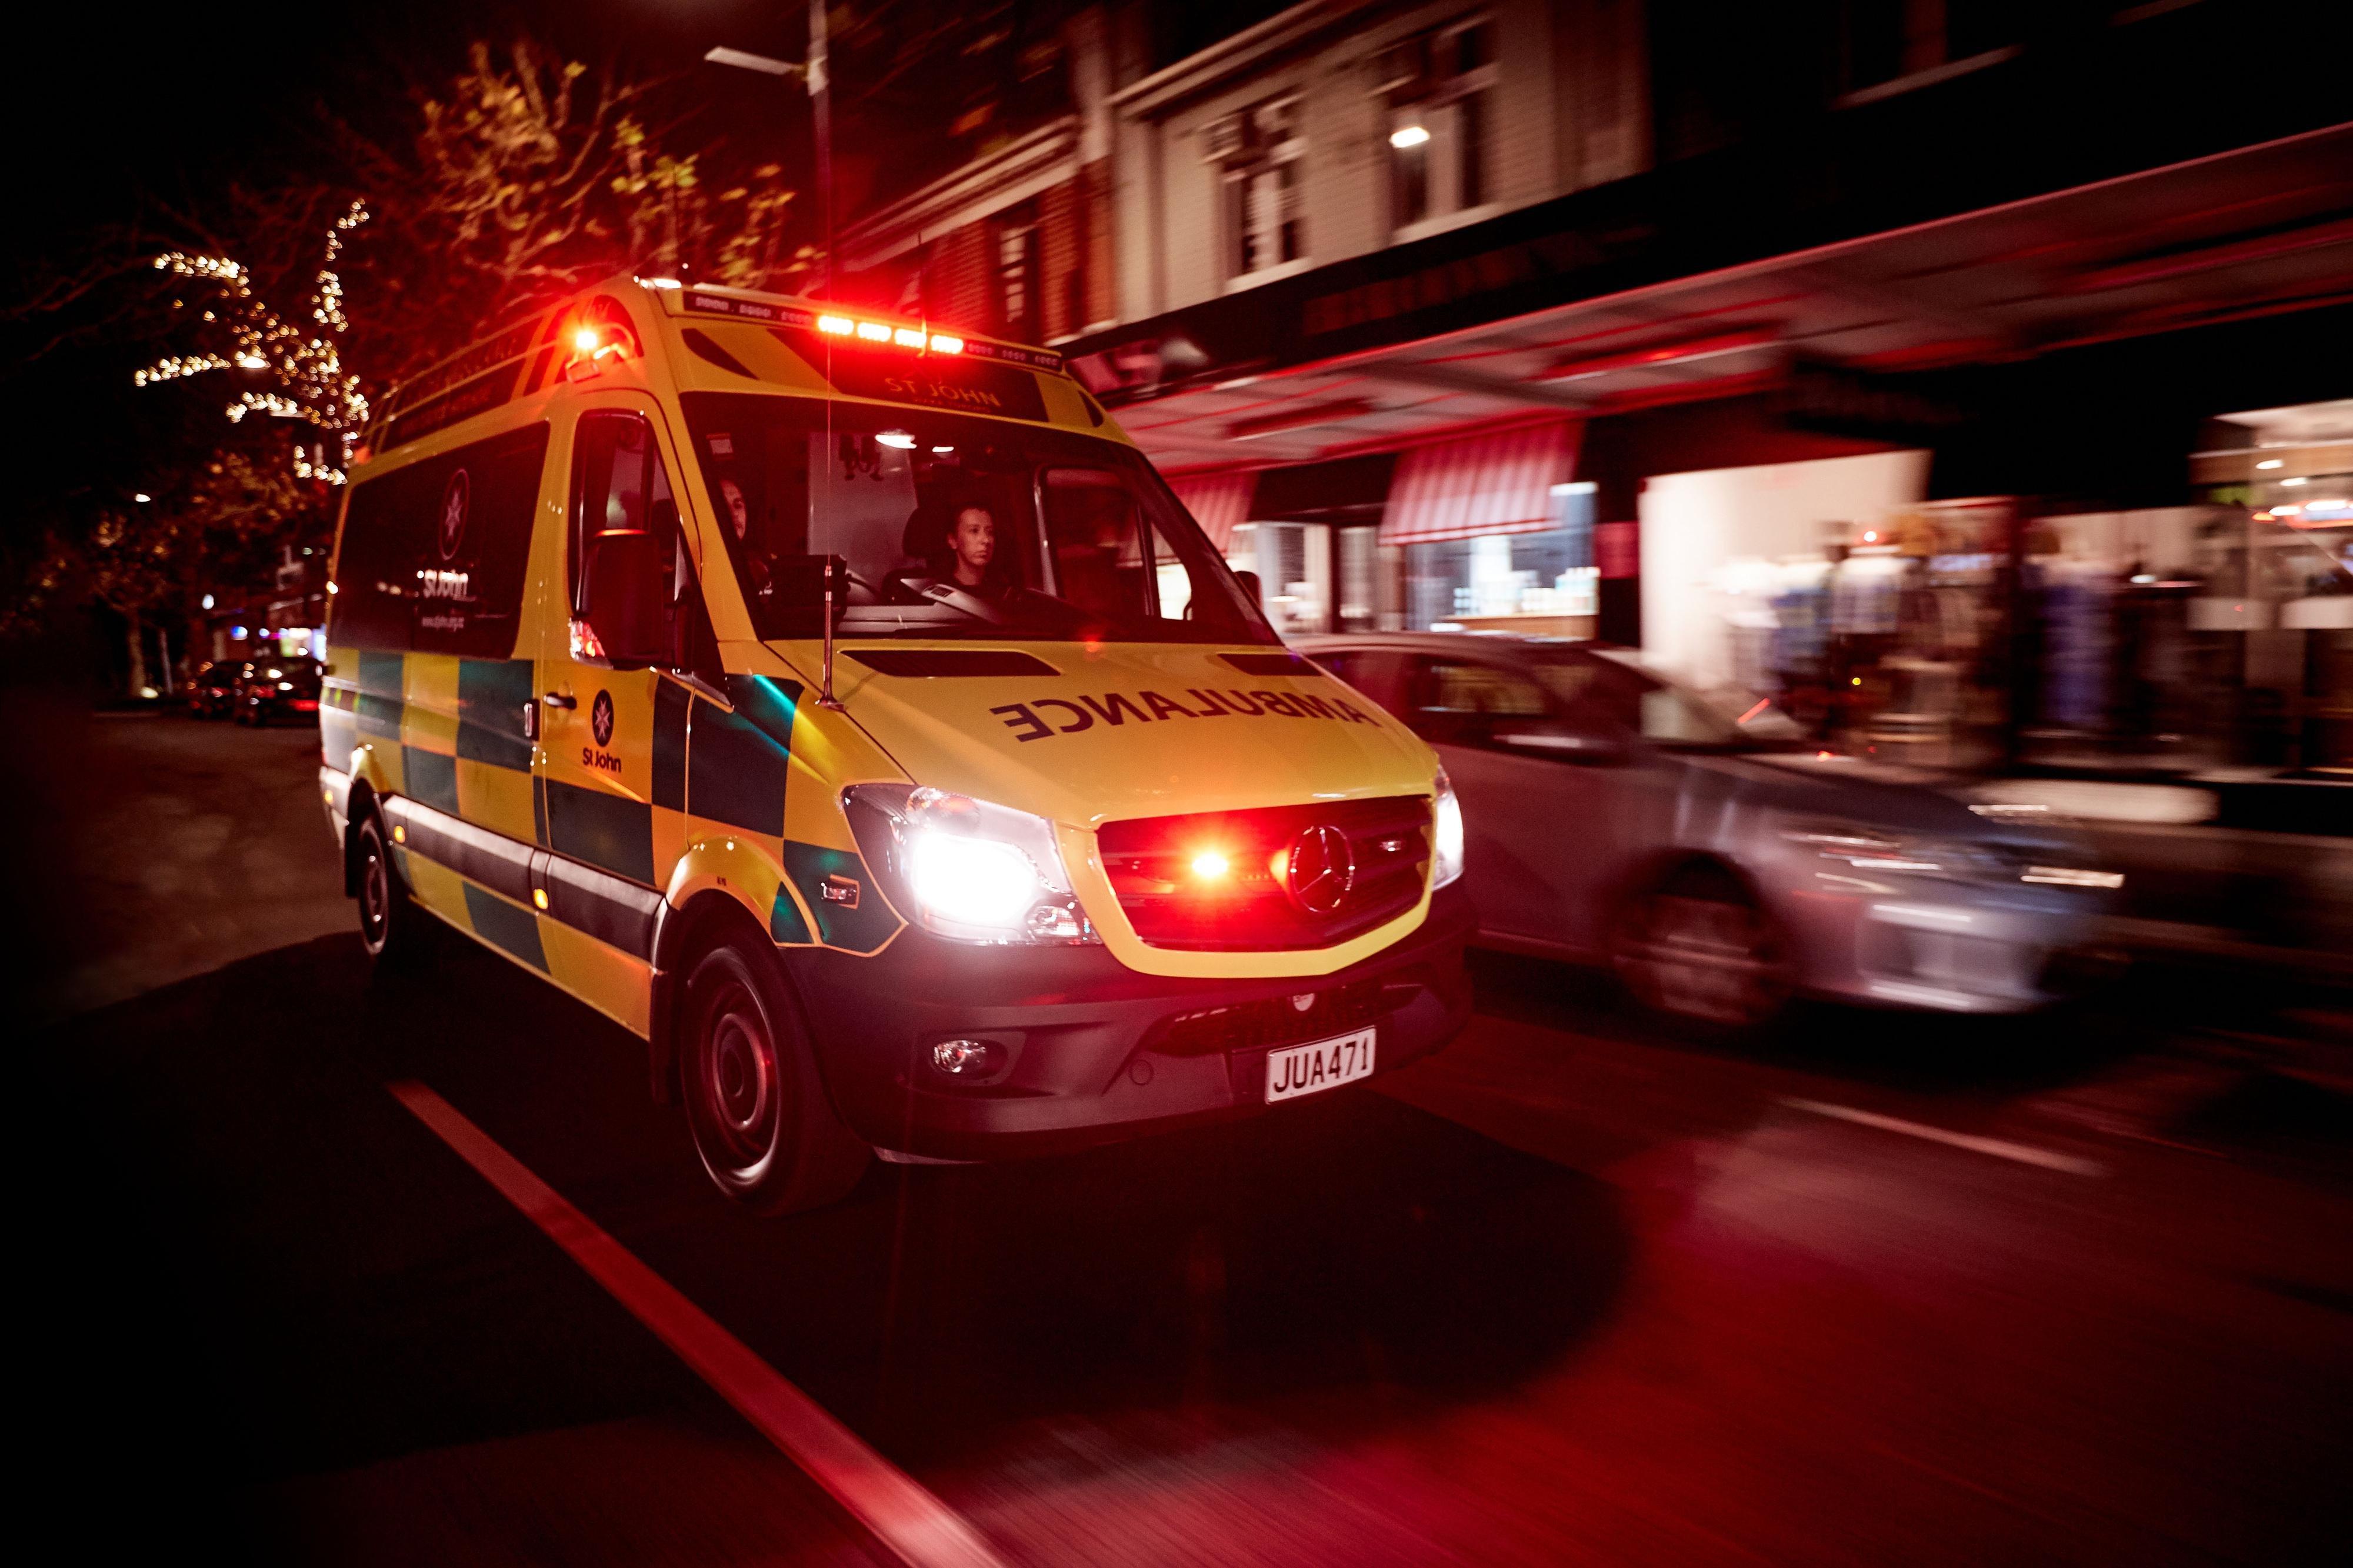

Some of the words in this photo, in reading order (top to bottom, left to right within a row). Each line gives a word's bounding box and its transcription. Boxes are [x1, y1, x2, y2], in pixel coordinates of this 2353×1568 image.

[885, 378, 916, 393] ST
[929, 384, 1001, 406] JOHN
[583, 747, 593, 766] St
[595, 750, 621, 772] John
[1274, 1037, 1368, 1092] JUA471
